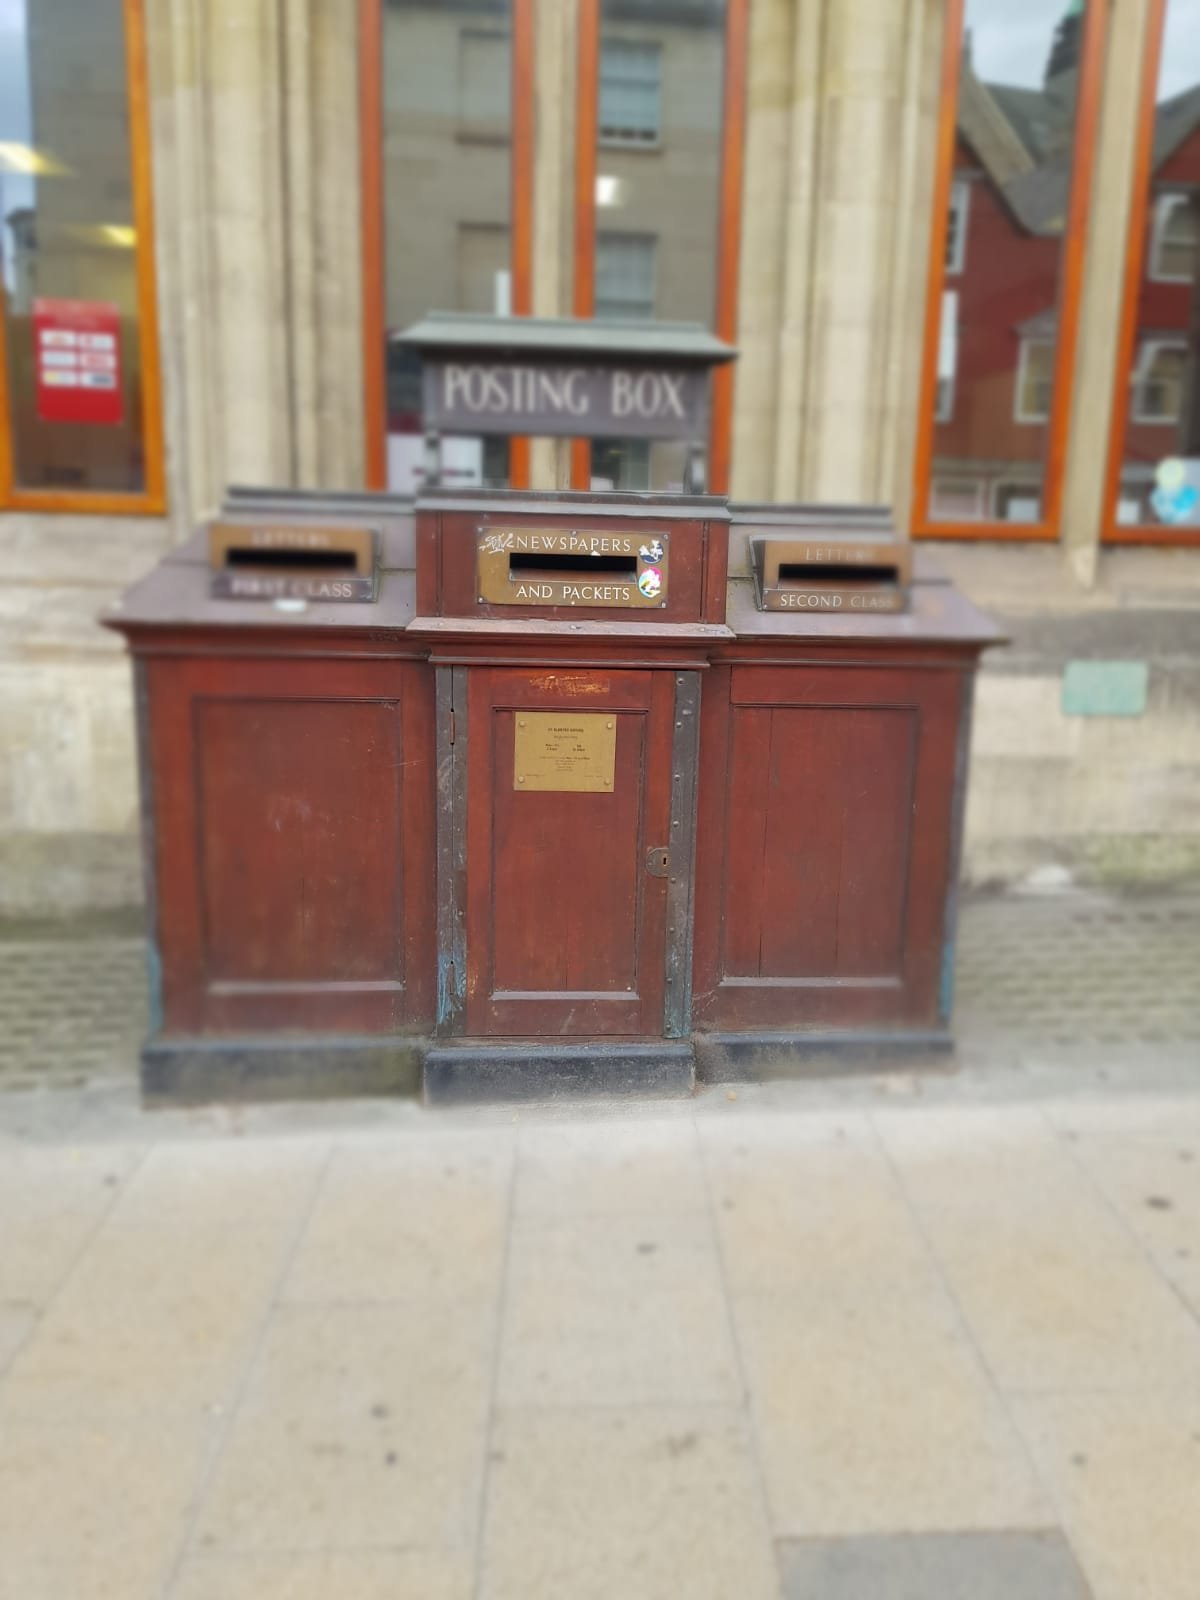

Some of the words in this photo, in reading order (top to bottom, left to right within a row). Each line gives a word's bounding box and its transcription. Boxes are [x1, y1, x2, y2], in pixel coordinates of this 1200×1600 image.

[444, 365, 589, 415] POSTING
[611, 370, 685, 418] BOX
[516, 535, 631, 552] NEWSPAPERS
[231, 579, 286, 595] FIRST
[290, 581, 353, 598] CLASS
[516, 585, 553, 599] AND
[562, 585, 630, 601] PACKETS
[780, 594, 842, 608] SECOND
[850, 595, 893, 609] CLASS
